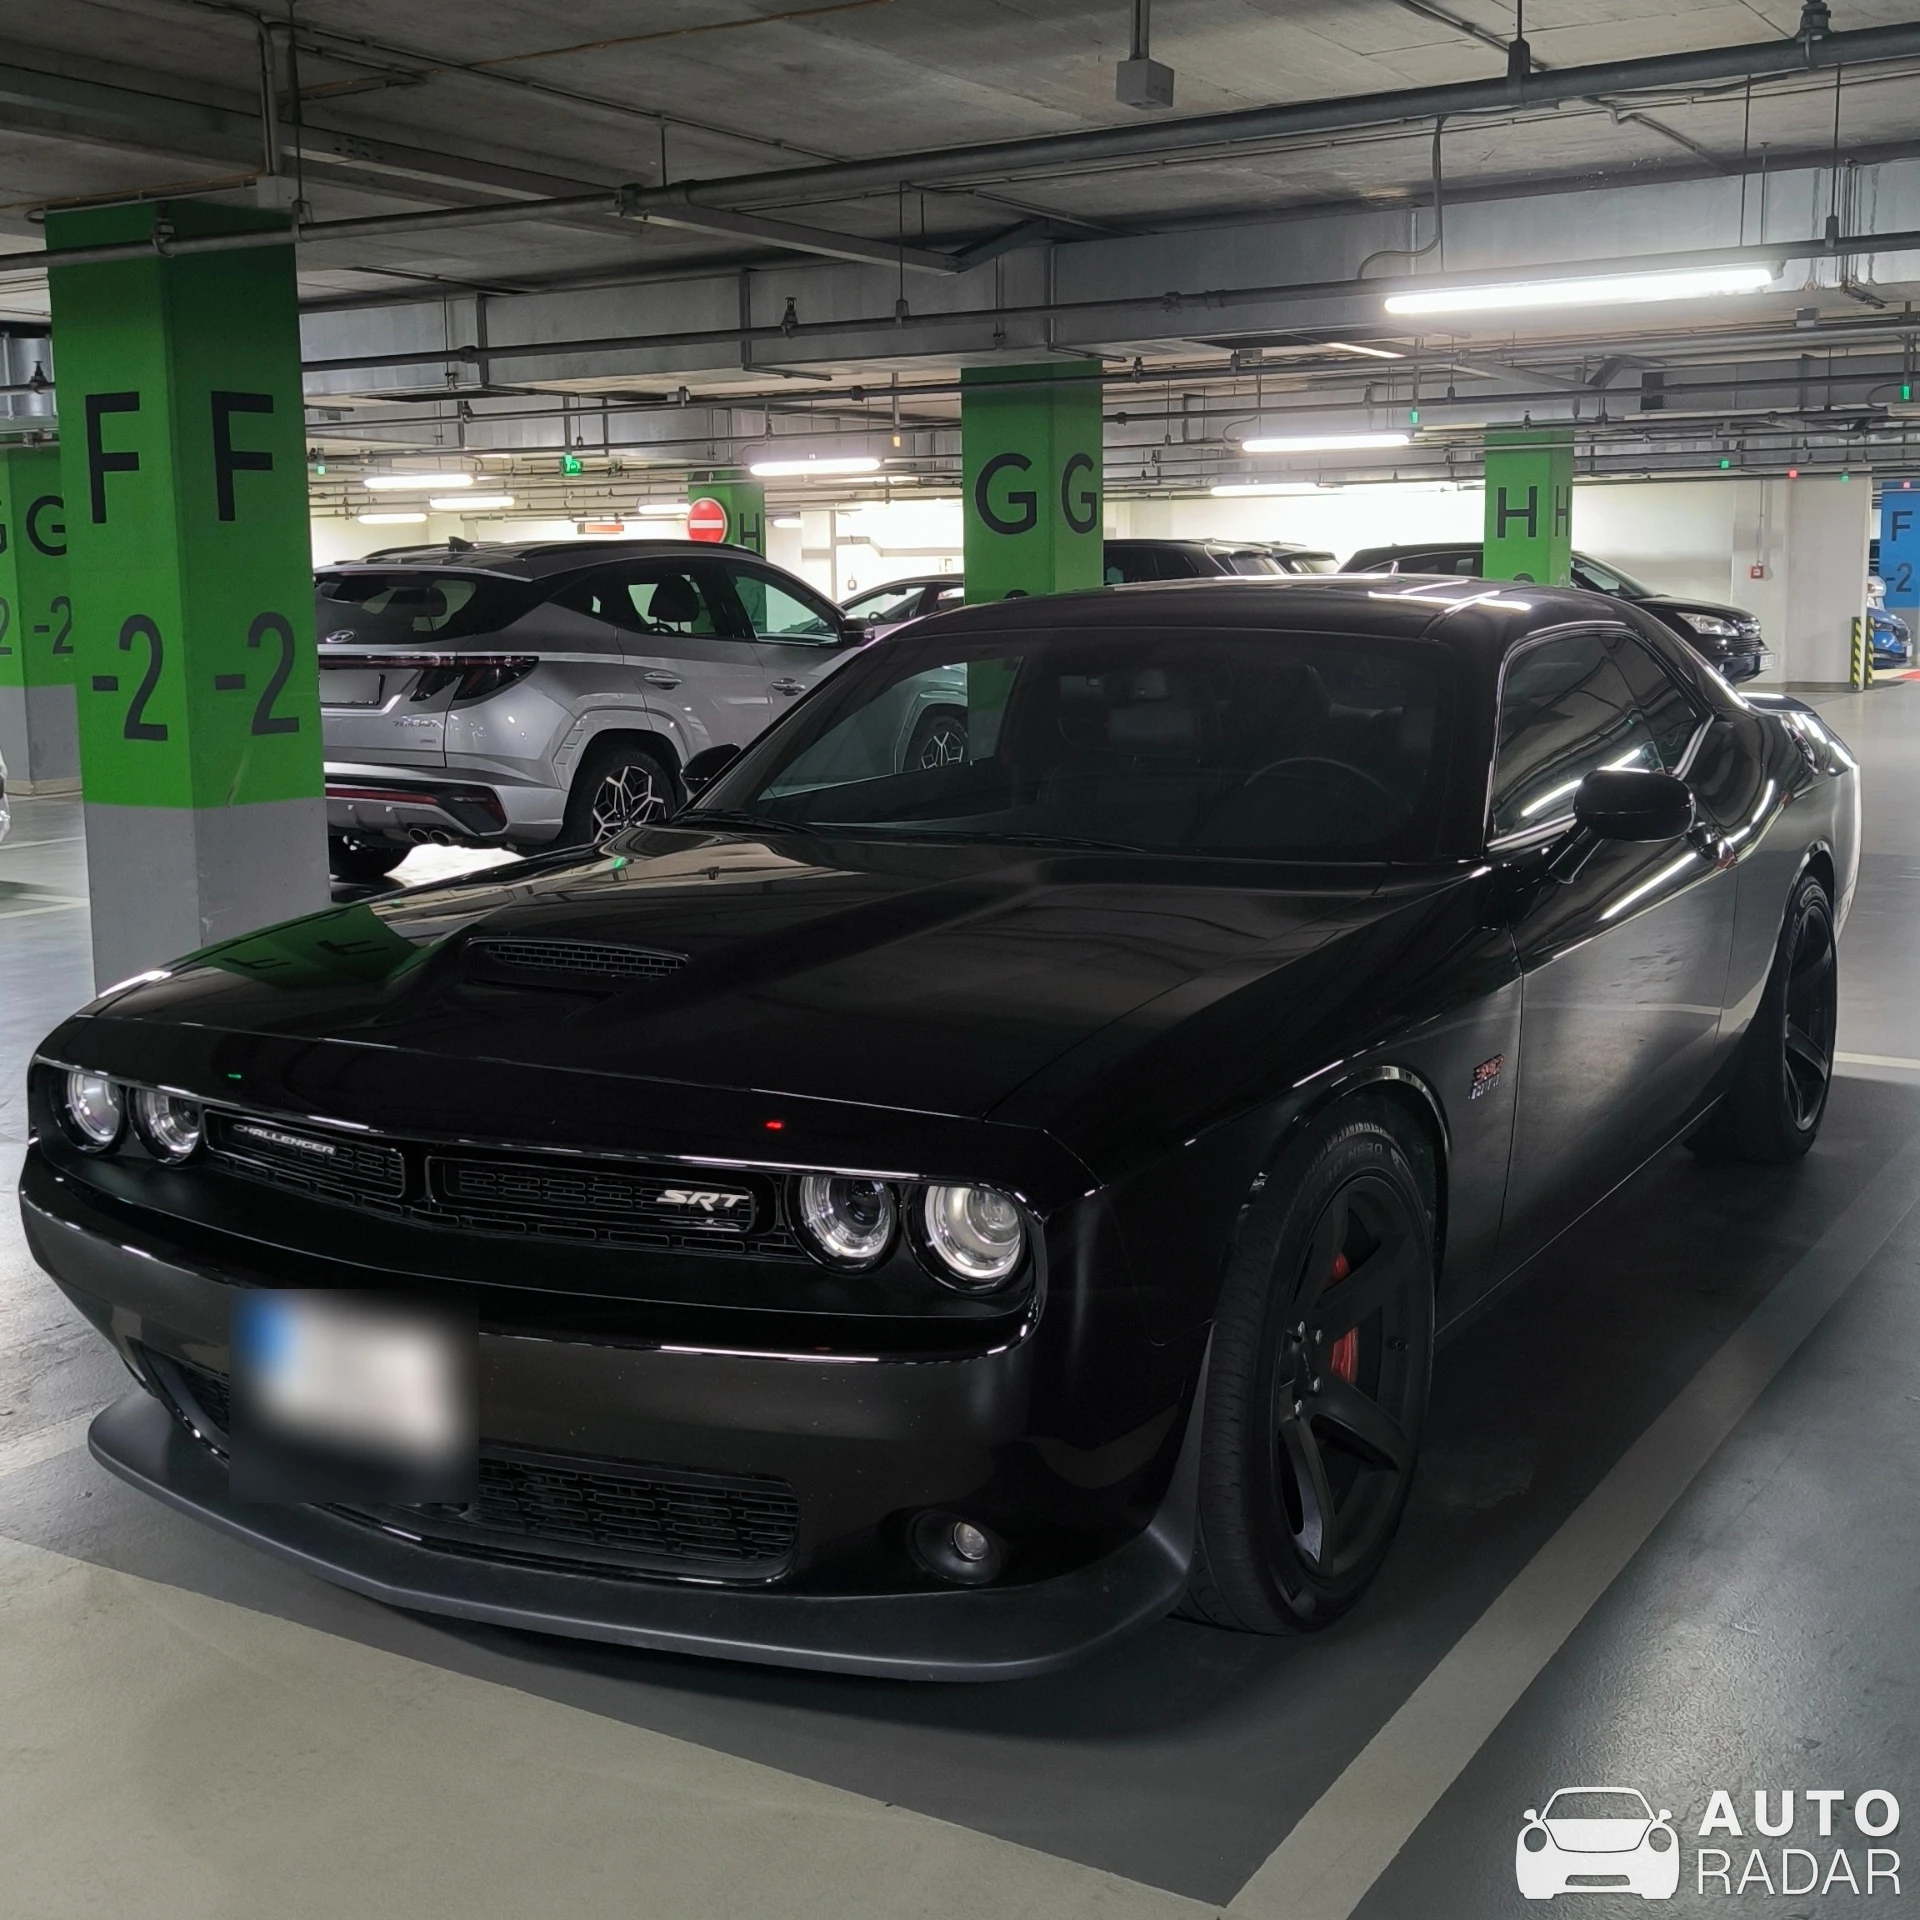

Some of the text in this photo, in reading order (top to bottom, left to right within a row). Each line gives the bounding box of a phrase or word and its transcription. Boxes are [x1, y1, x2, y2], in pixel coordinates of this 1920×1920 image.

[85, 391, 140, 524] F
[211, 390, 274, 522] F
[974, 452, 1038, 535] G
[1061, 452, 1098, 534] G
[1497, 486, 1538, 538] H
[1554, 485, 1569, 537] H
[26, 495, 68, 556] G
[739, 512, 760, 553] H
[1891, 510, 1913, 541] F
[1886, 562, 1914, 592] -2
[34, 596, 74, 655] -2
[92, 614, 168, 741] -2
[215, 612, 300, 736] -2
[233, 1124, 337, 1155] CHALLENGER
[656, 1189, 750, 1212] SRT
